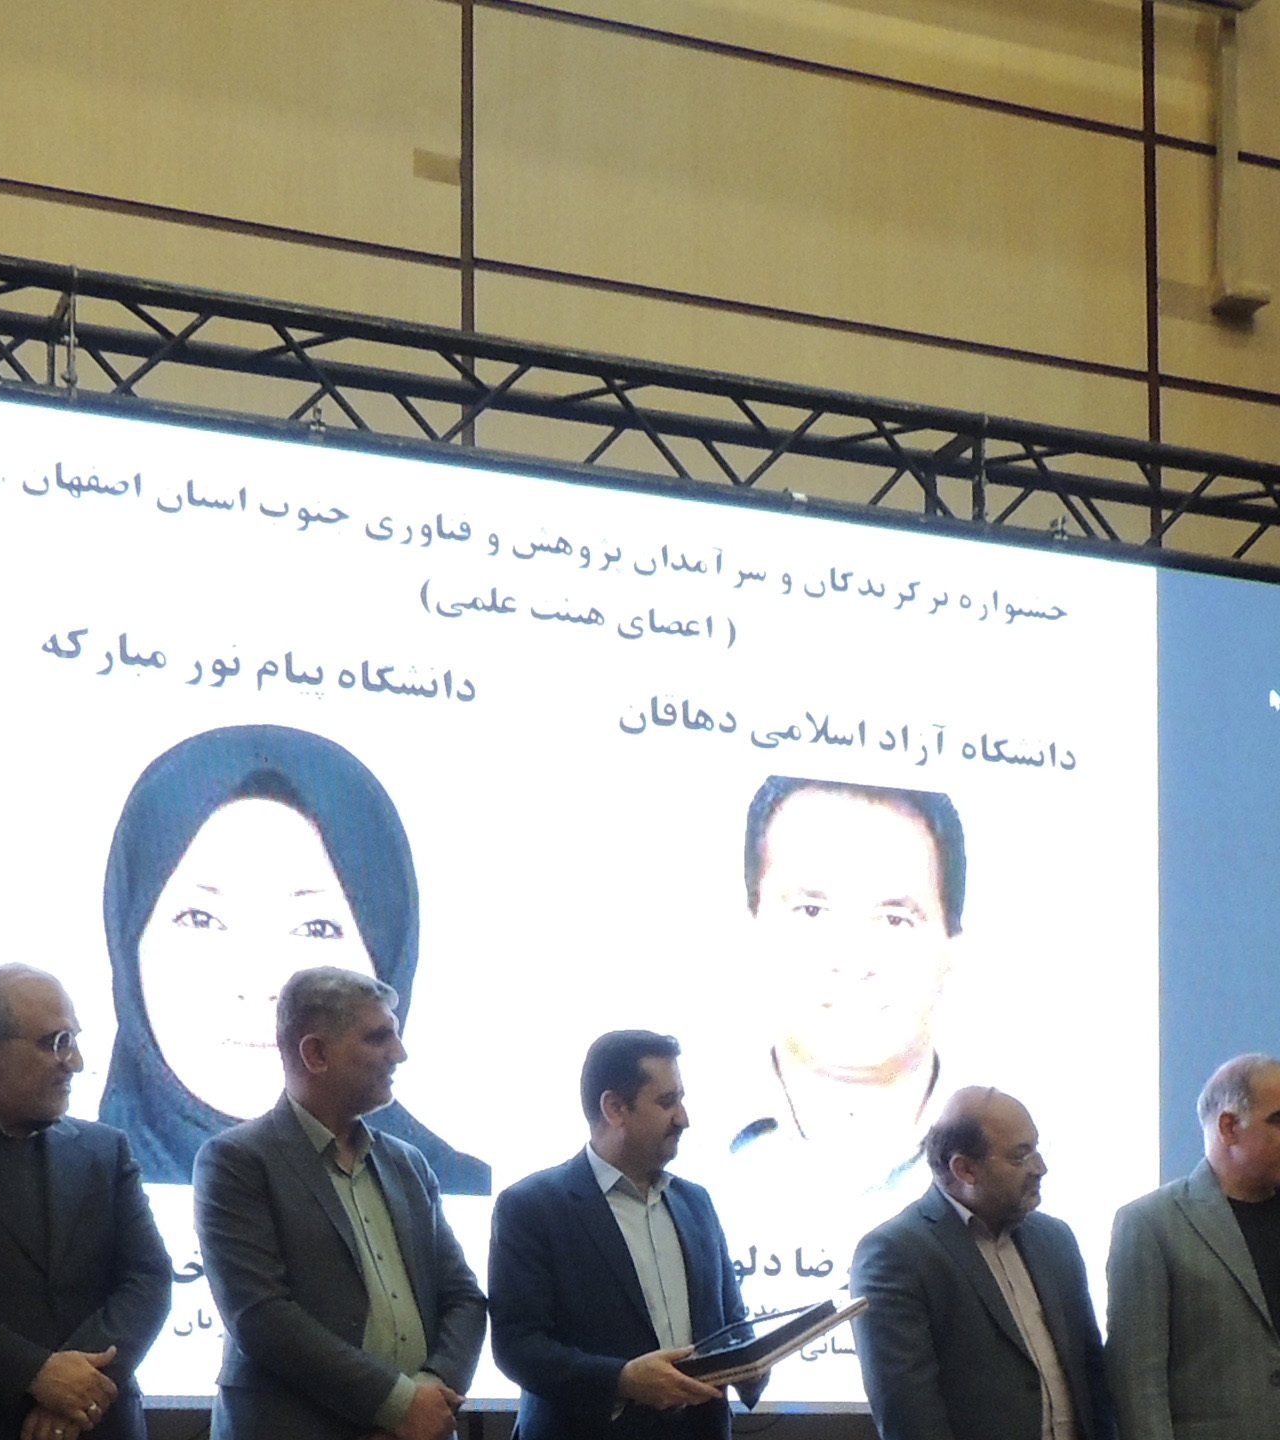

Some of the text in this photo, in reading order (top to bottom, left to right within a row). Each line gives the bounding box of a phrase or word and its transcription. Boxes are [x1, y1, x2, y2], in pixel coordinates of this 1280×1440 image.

[22, 461, 142, 499] اصفهان
[156, 479, 247, 514] استان
[259, 499, 350, 534] جنوب
[365, 511, 472, 548] فناوری
[487, 532, 500, 557] و
[781, 572, 793, 595] و
[185, 645, 241, 688] نور
[256, 651, 324, 701] پیام
[337, 660, 476, 703] دانشگاه
[619, 694, 1077, 771] دانشگاه آزاد اسلامی دهاقان
